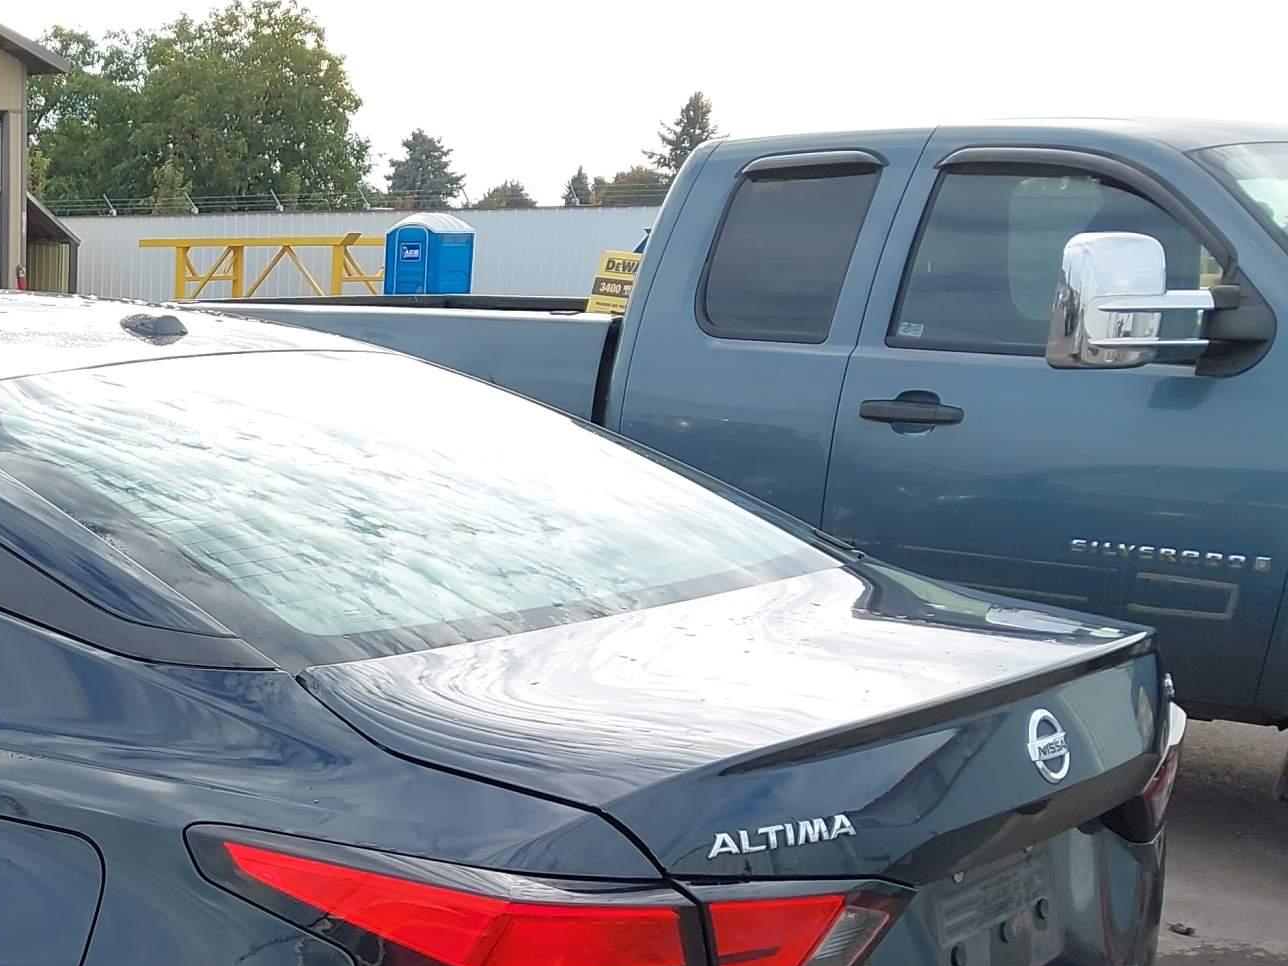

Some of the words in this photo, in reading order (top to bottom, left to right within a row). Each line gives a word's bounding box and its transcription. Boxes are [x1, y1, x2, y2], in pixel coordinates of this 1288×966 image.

[599, 282, 622, 294] 3400
[1070, 538, 1247, 570] SILVERADO
[1037, 739, 1069, 757] NISSA
[707, 813, 857, 859] ALTIMA
